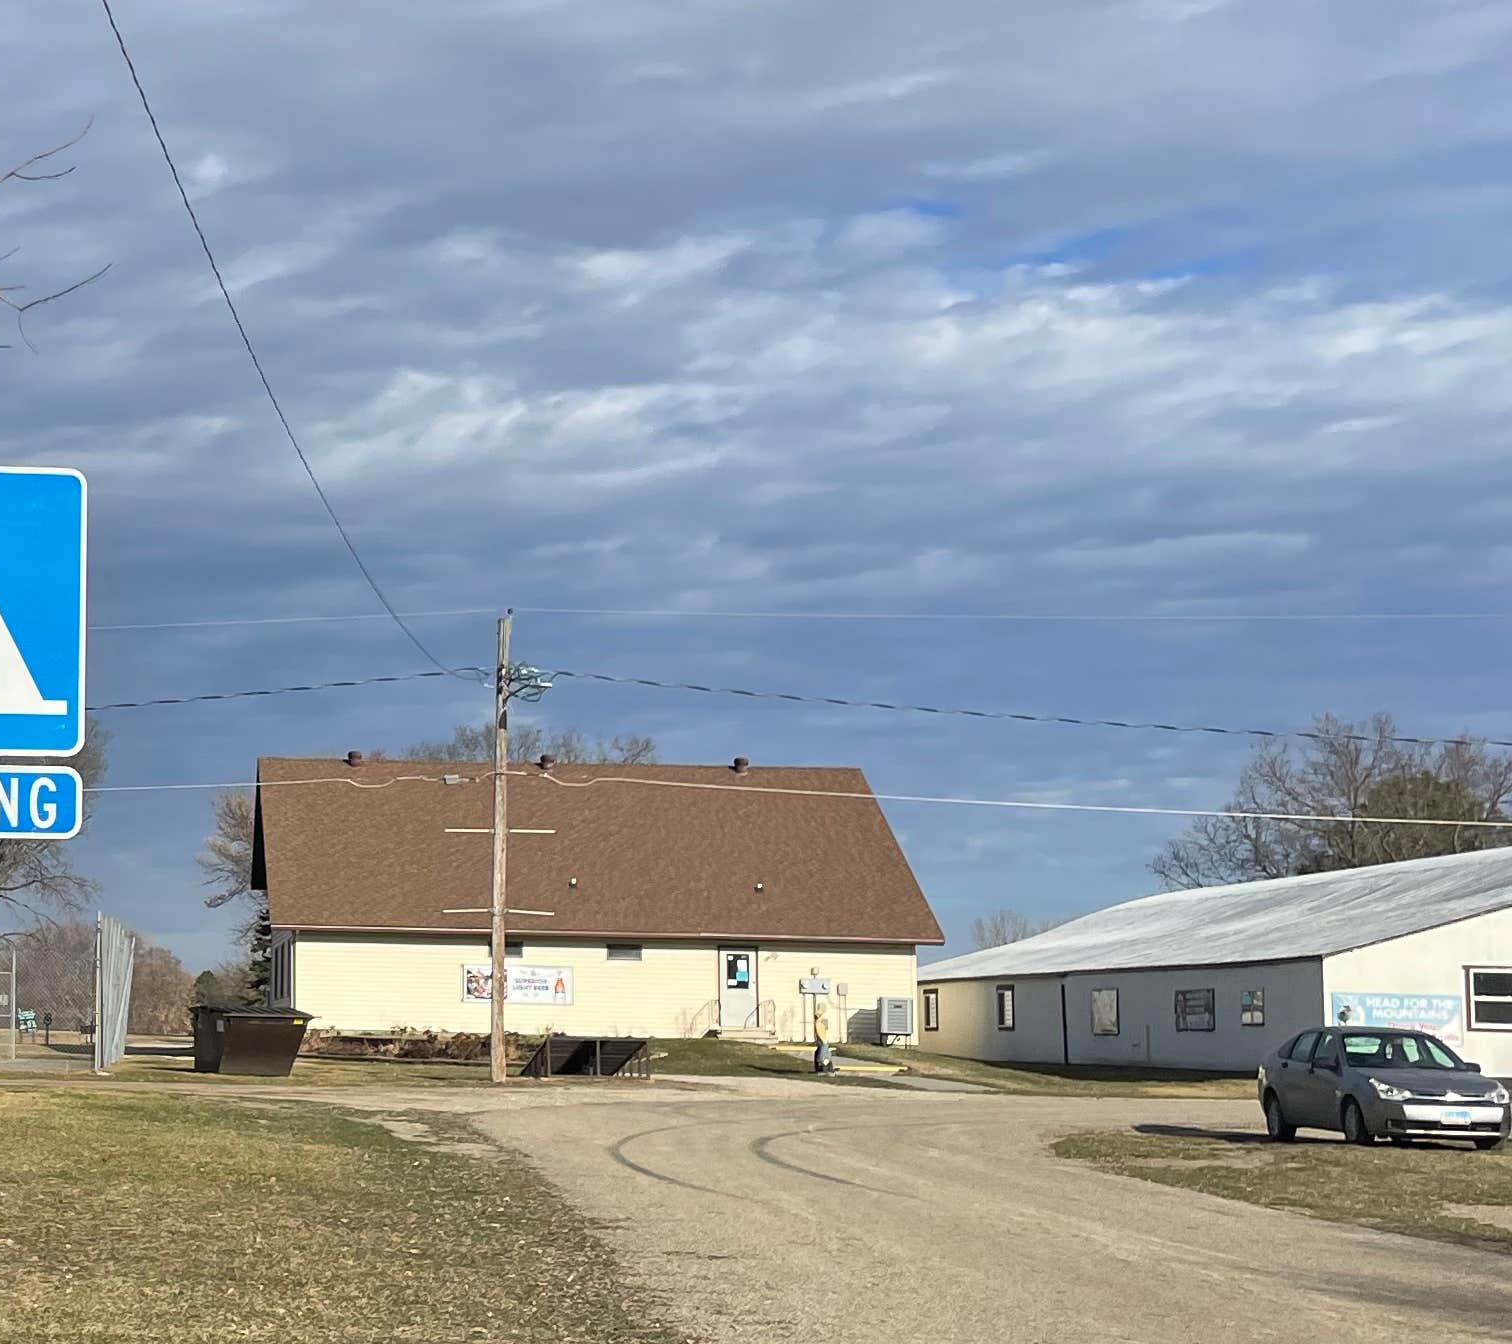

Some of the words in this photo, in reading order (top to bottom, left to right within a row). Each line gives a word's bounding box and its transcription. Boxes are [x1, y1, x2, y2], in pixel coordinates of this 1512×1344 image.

[1365, 996, 1400, 1008] HEAD
[1403, 997, 1428, 1009] FOR
[1431, 998, 1454, 1009] THE
[1372, 1007, 1450, 1020] MOUNTAINS
